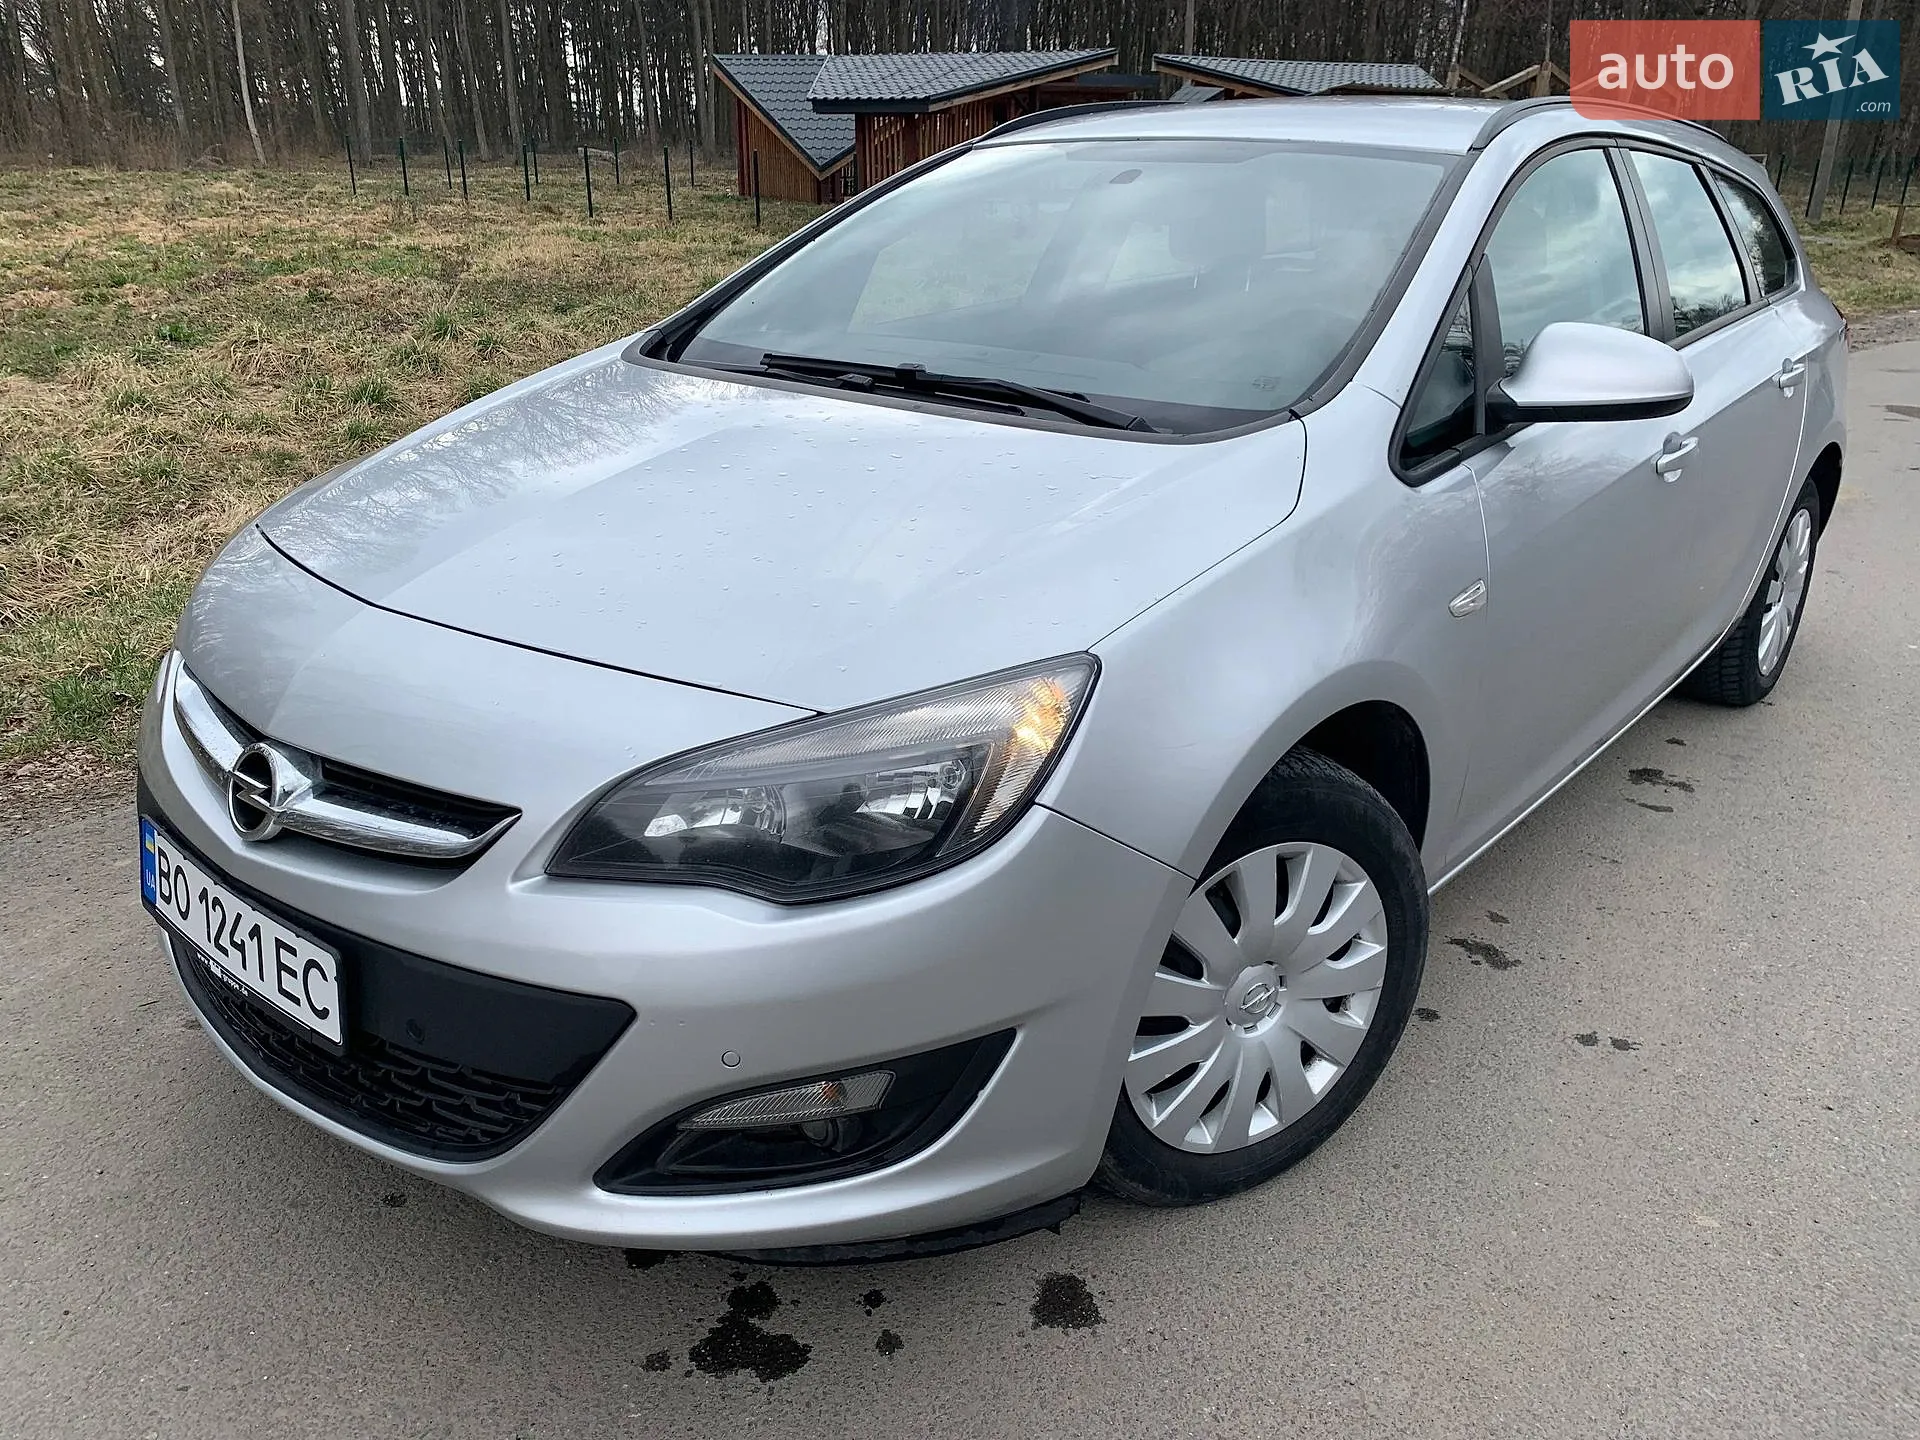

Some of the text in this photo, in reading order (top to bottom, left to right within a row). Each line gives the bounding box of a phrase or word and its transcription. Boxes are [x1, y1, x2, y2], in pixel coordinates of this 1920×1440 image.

[145, 869, 156, 890] UA
[157, 845, 191, 921] BO
[198, 886, 265, 983] 1241
[274, 936, 330, 1020] EC
